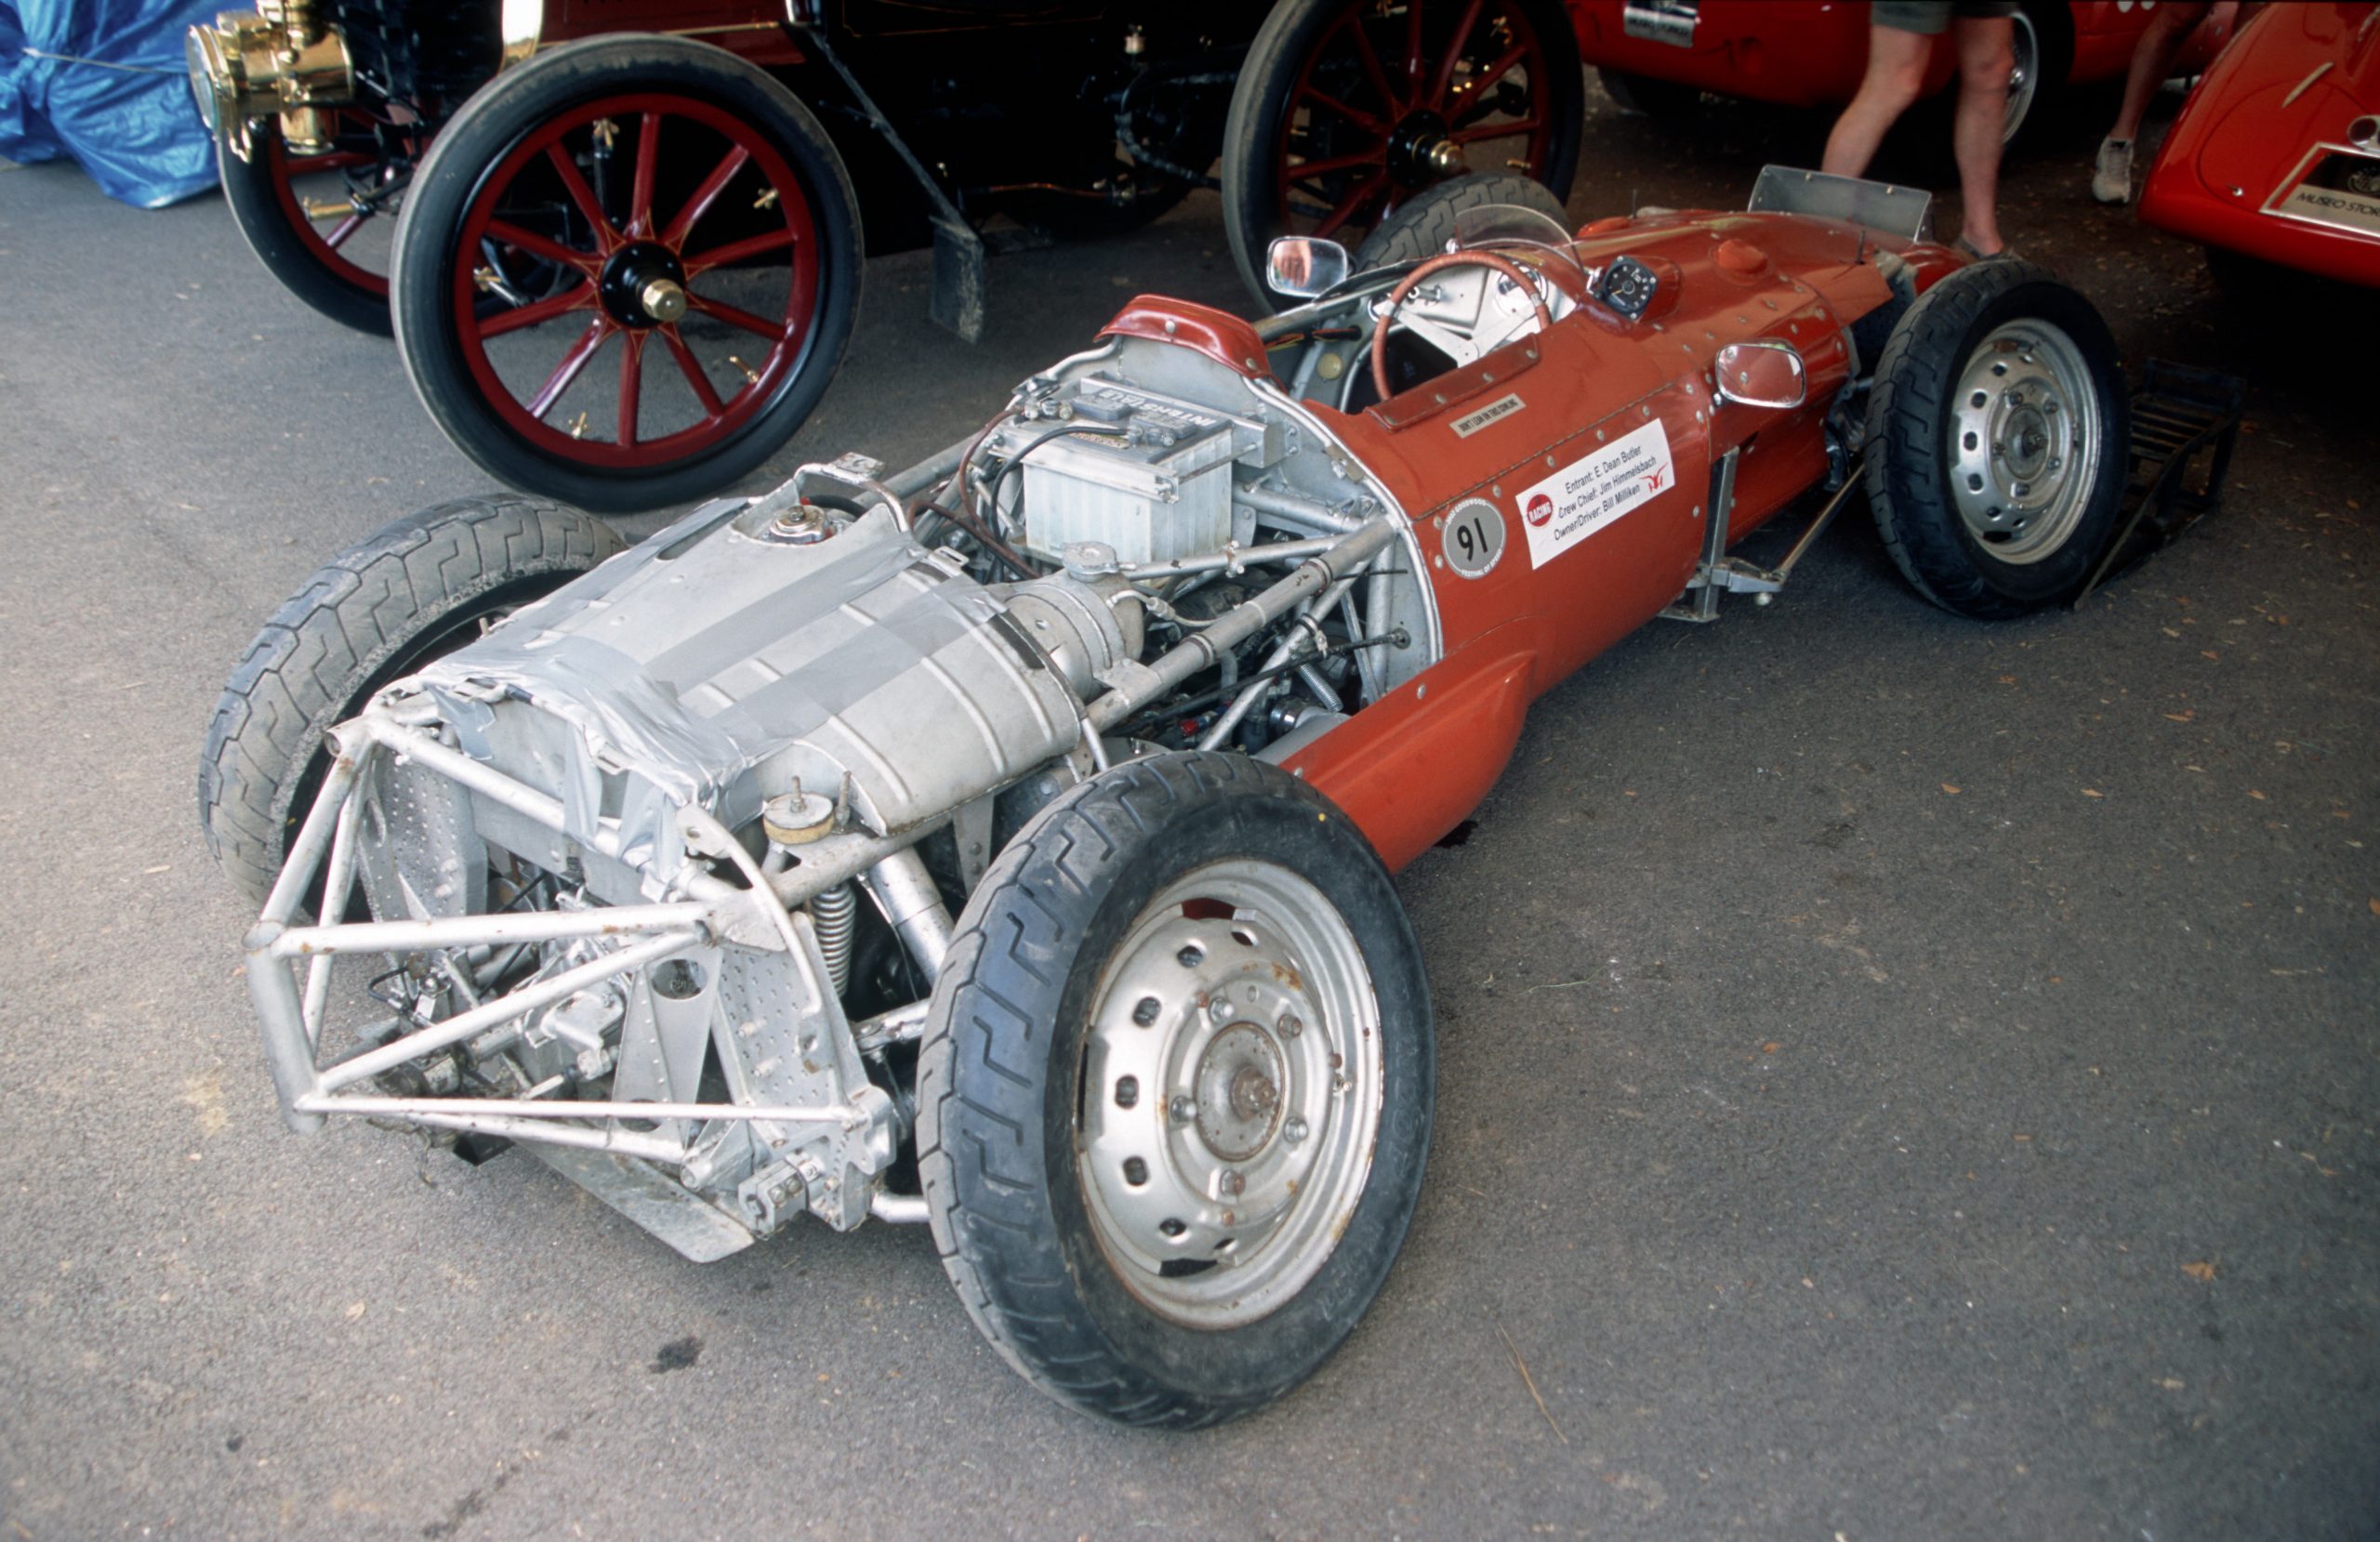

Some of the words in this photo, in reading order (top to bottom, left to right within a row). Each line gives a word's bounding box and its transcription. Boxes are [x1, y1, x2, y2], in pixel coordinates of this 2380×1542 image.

[2296, 192, 2346, 208] MUSEO
[1558, 504, 1577, 520] Crew
[1577, 489, 1598, 507] Chief:
[1600, 481, 1613, 495] Jim
[1613, 455, 1658, 486] Himmelsbach
[1565, 472, 1593, 494] Entrant:
[1594, 466, 1603, 478] E.
[1603, 458, 1621, 474] Dean
[1620, 445, 1642, 463] Butler
[1528, 502, 1553, 522] RACING
[1602, 496, 1615, 512] Bill
[1615, 483, 1641, 505] Milliken
[1457, 517, 1488, 561] 91
